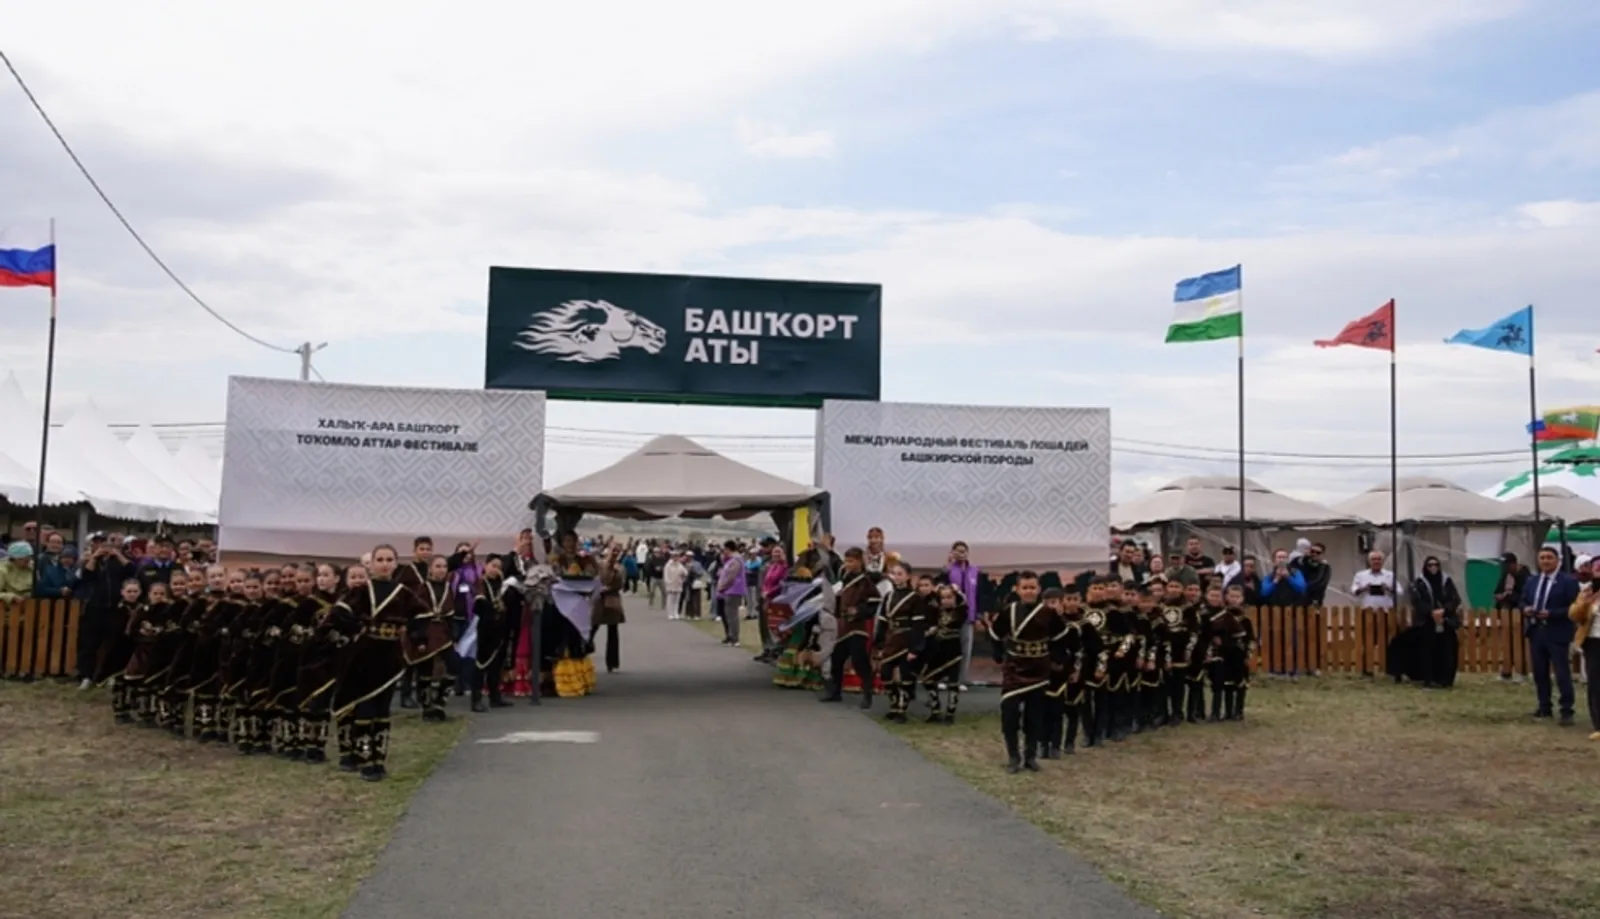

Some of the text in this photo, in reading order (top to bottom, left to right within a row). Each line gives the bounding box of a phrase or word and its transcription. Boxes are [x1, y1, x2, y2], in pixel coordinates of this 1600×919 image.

[685, 308, 858, 339] БАШҠОРТ
[684, 337, 759, 365] АТЫ
[361, 436, 402, 449] АТТАР
[403, 438, 479, 453] ФЕСТИВАЛЕ
[844, 434, 1089, 453] МЕЖДУНАРОДНЫЙ ФЕСТИВАЛЬ ЛОШАДЕЙ
[901, 451, 1034, 466] БАШКИРСКОЙ ПОРОДЫ
